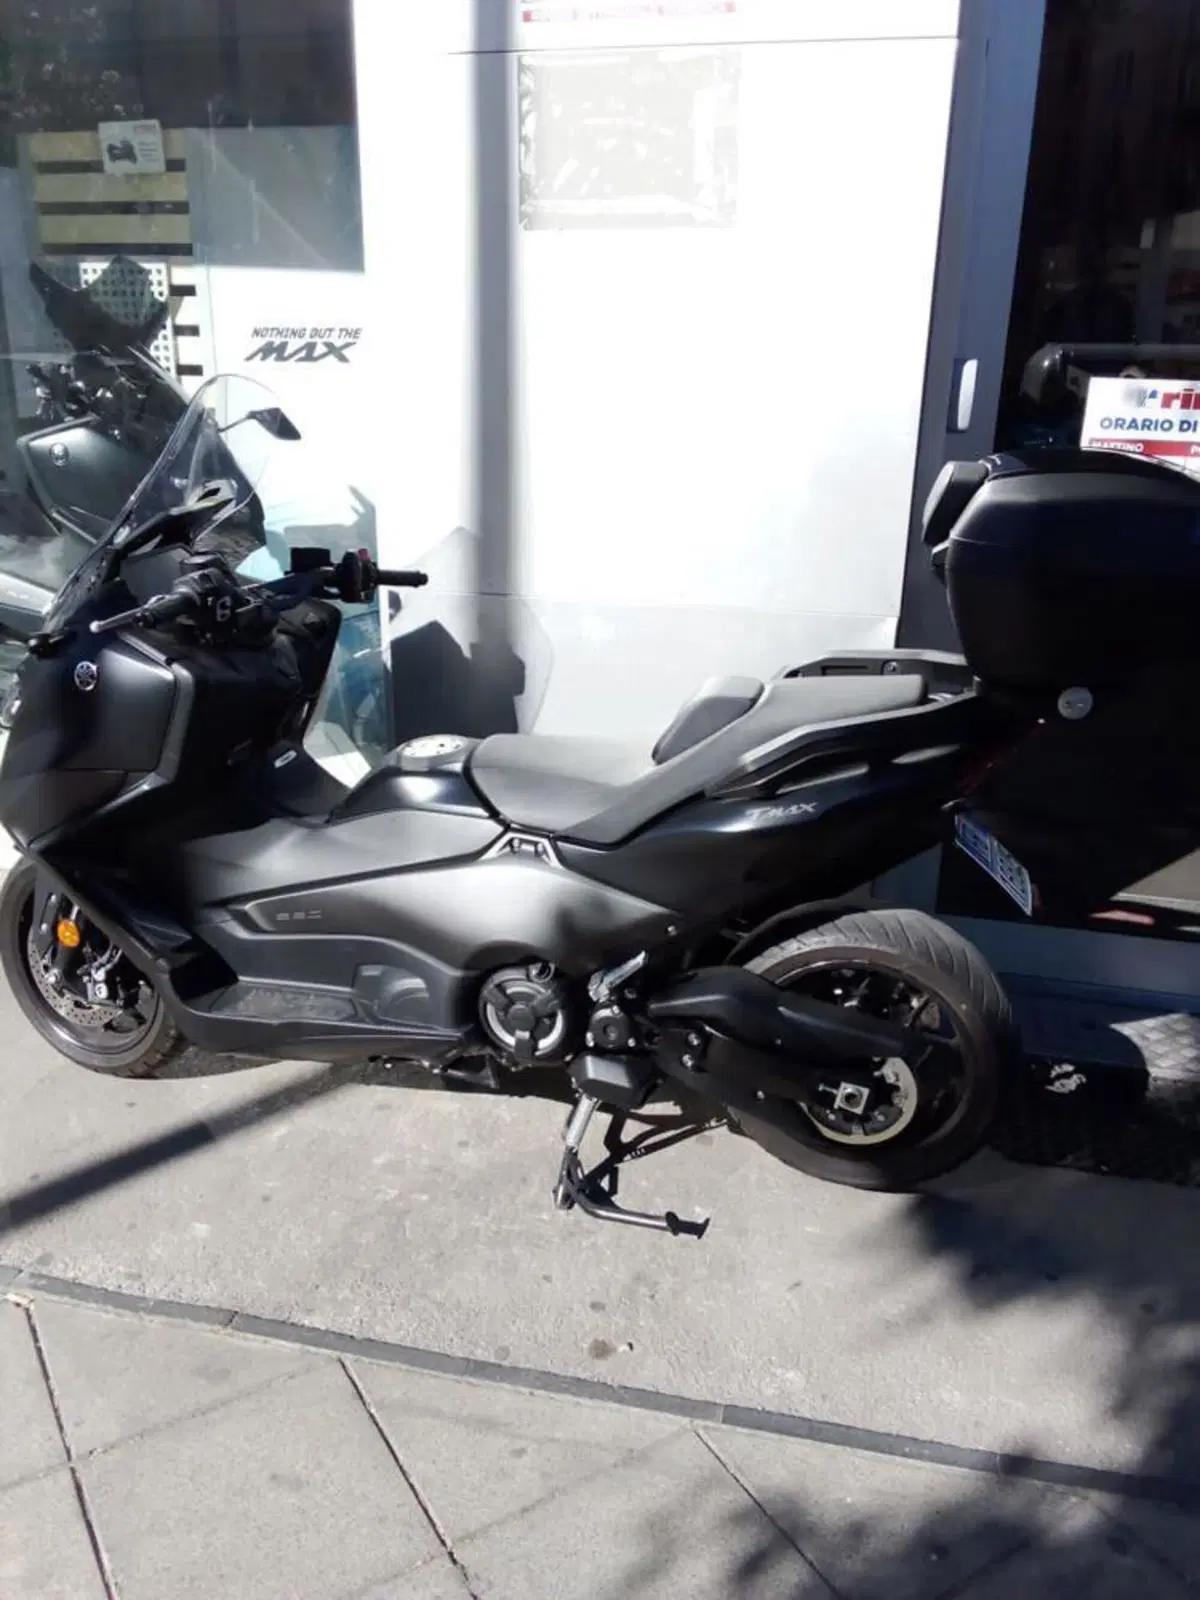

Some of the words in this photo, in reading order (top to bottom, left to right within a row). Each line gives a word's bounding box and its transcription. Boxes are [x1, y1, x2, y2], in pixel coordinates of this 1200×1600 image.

[251, 327, 307, 339] NOTHING
[337, 327, 362, 339] THE
[243, 340, 357, 363] MAX
[1100, 417, 1174, 432] ORARIO
[1178, 420, 1198, 433] DI
